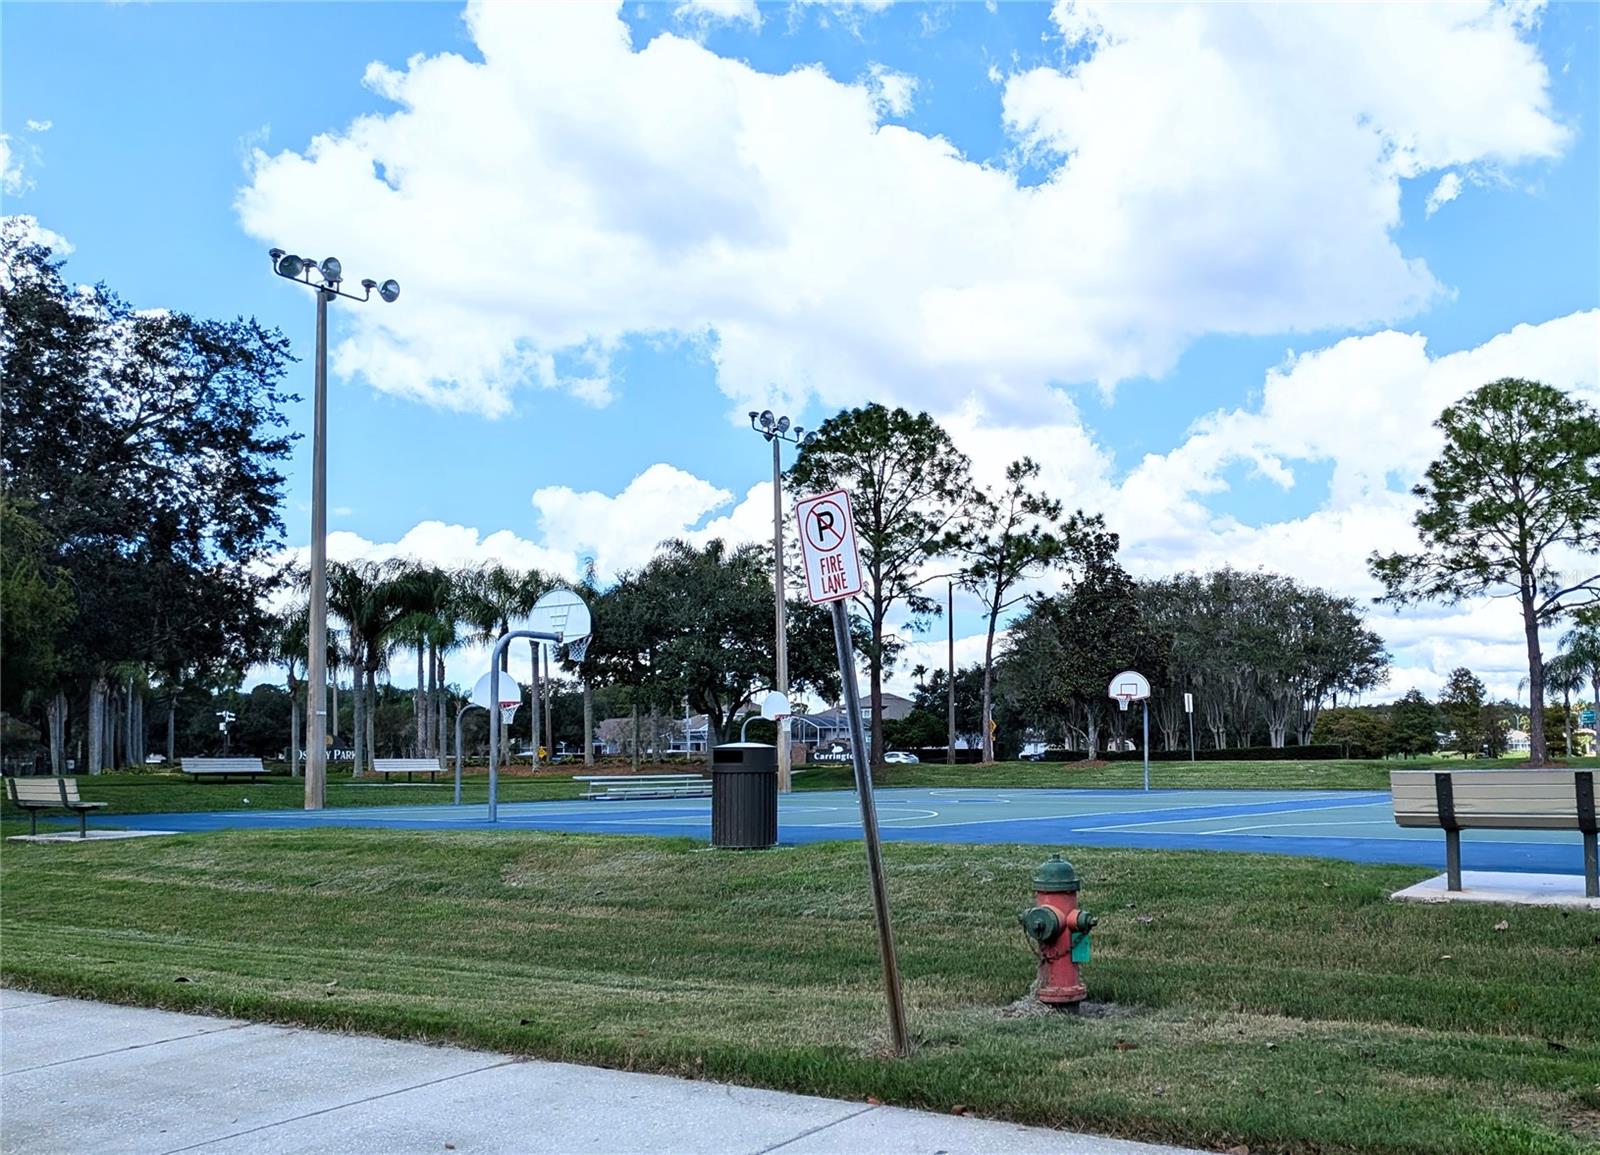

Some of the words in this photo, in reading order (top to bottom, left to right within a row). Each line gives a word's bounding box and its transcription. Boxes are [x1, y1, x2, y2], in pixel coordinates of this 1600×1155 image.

[817, 511, 834, 541] P
[820, 554, 843, 575] FIRE
[821, 572, 848, 594] LANE
[814, 752, 855, 761] Carringto
